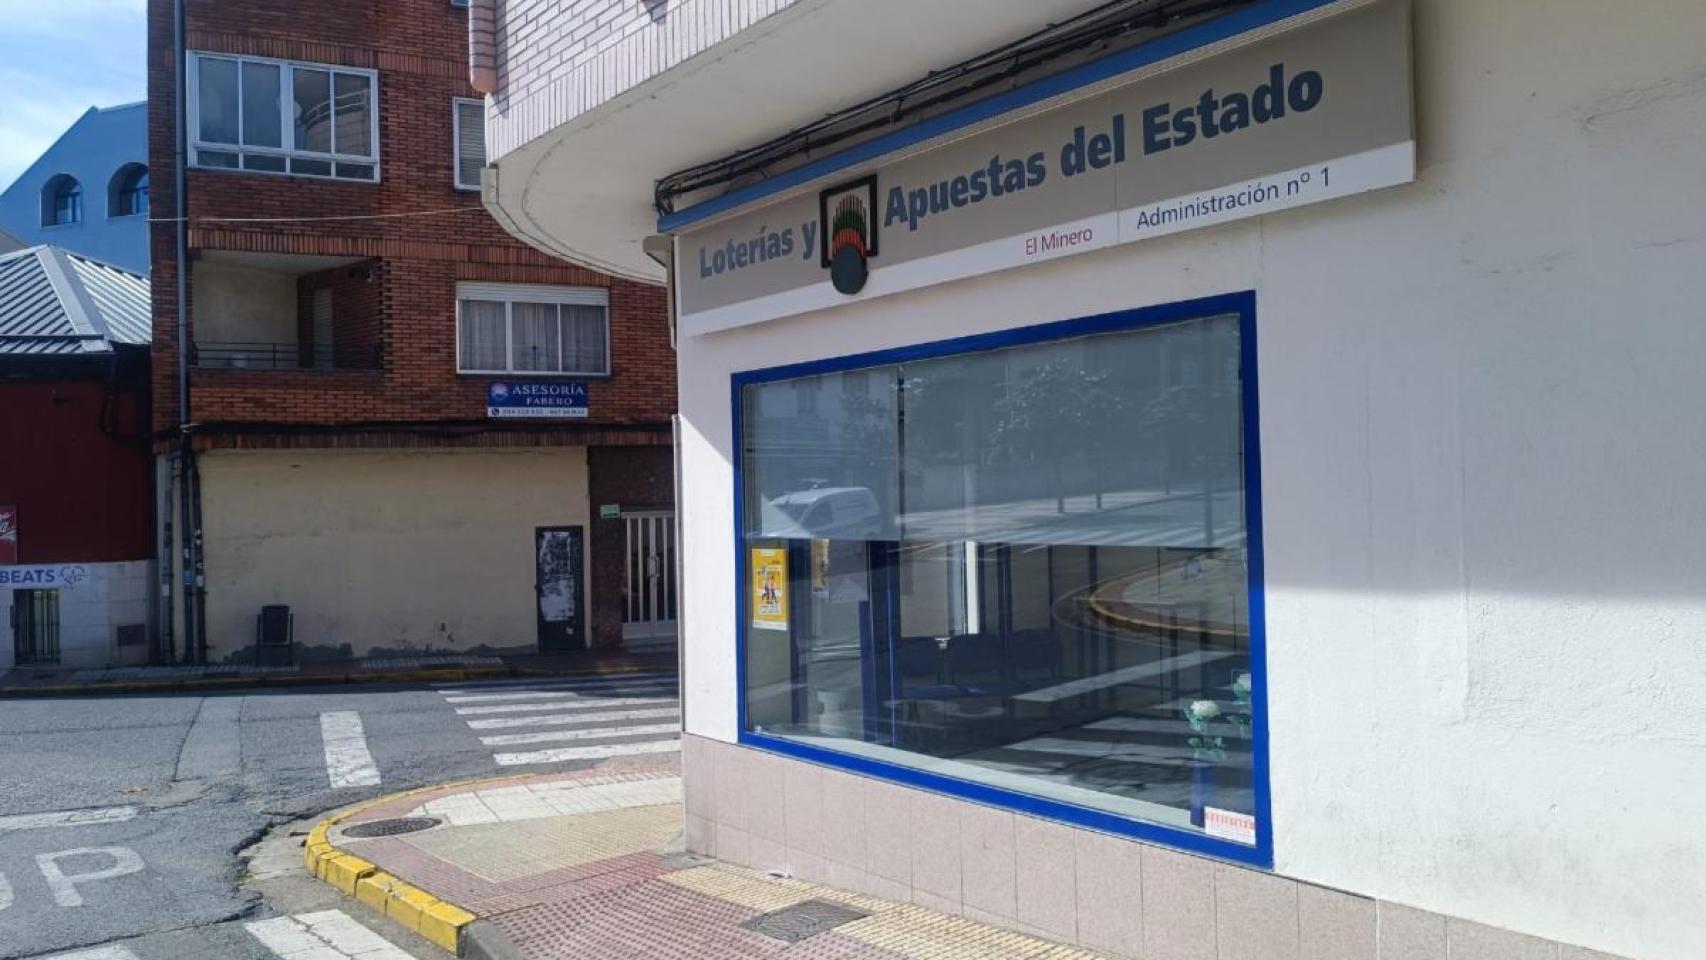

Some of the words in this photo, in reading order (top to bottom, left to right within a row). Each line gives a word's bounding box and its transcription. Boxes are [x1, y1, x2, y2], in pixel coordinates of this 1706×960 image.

[699, 223, 794, 279] Loterías
[801, 219, 817, 260] y
[883, 150, 1046, 231] Apuestas
[1061, 113, 1125, 178] del
[1143, 63, 1323, 155] Estado
[1136, 181, 1280, 231] Administración
[1320, 167, 1332, 188] 1
[1025, 238, 1038, 256] El
[1041, 226, 1093, 254] Minero
[513, 384, 584, 395] ASESORÍA
[527, 397, 572, 406] FABERO
[0, 569, 55, 584] BEATS
